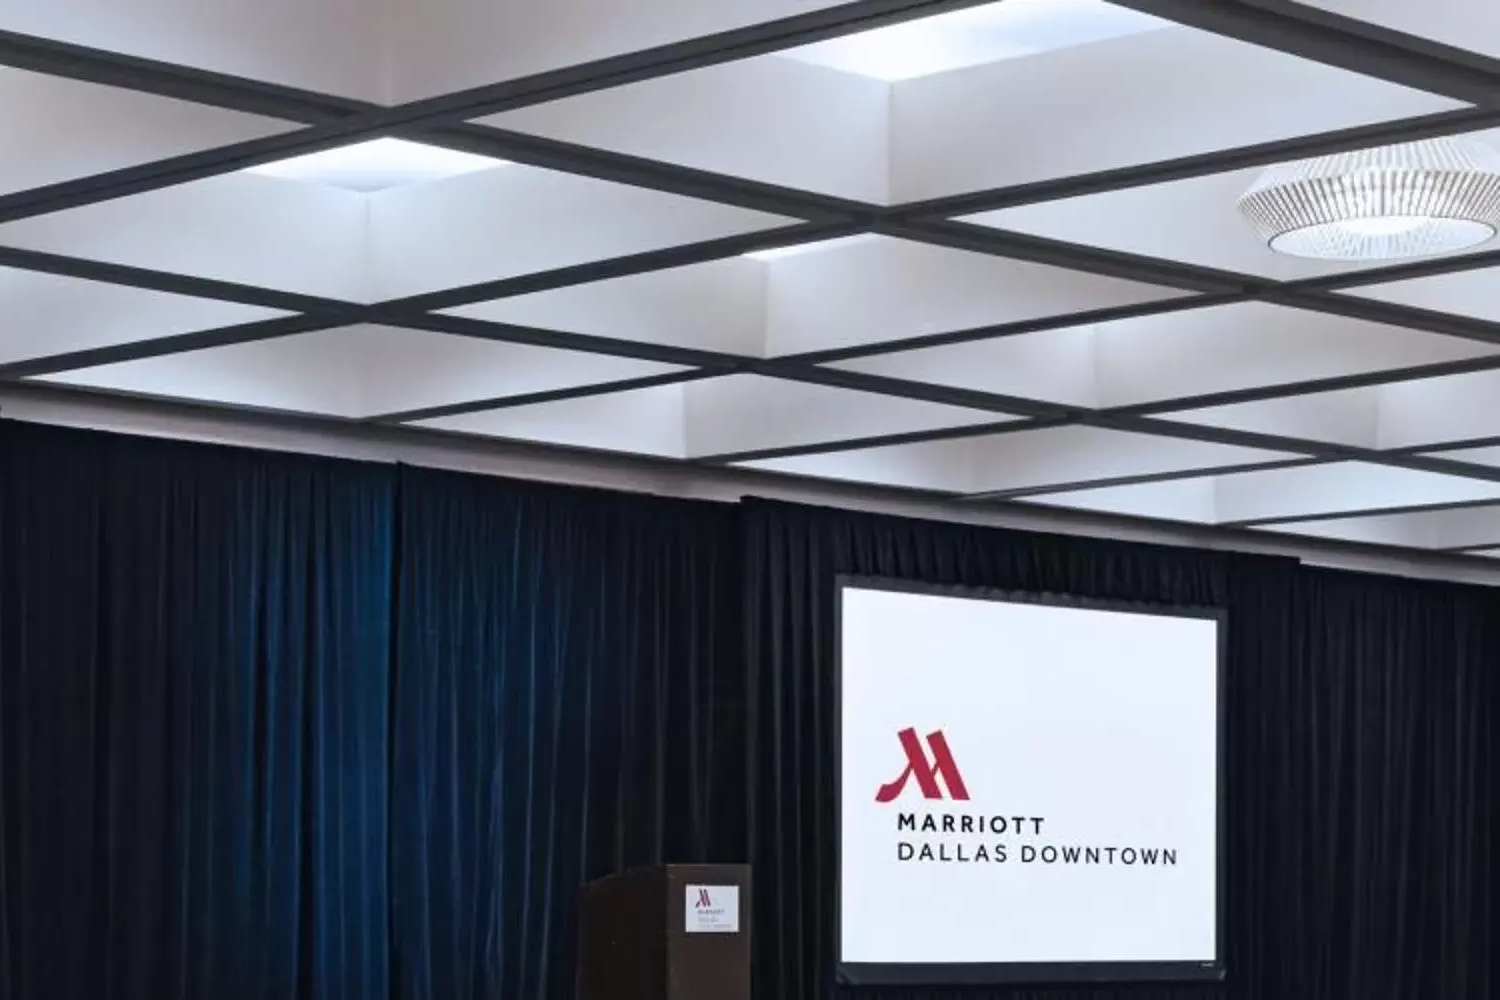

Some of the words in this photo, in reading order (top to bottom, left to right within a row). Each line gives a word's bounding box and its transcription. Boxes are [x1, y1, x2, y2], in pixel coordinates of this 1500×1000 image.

[897, 812, 1046, 836] MARRIOTT
[897, 841, 1008, 863] DALLAS
[1020, 844, 1177, 866] DOWNTOWN
